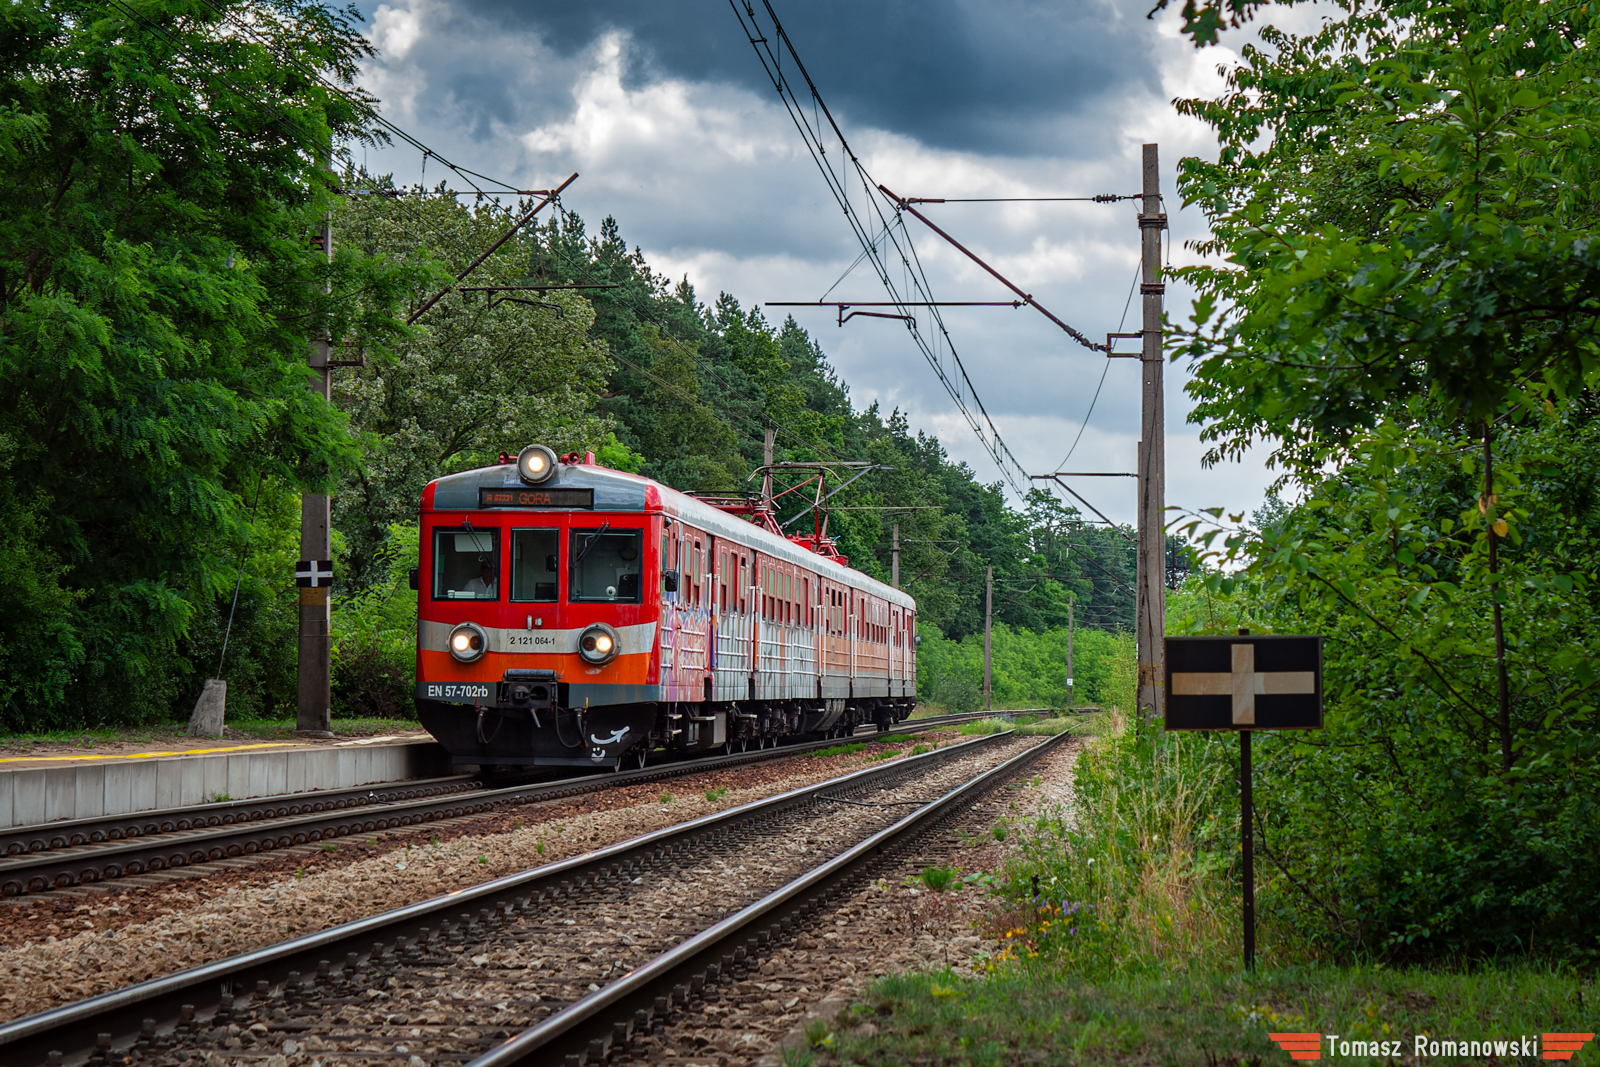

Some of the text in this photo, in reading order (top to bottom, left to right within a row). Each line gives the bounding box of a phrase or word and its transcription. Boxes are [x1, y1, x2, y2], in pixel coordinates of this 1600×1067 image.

[487, 494, 492, 502] R
[510, 637, 556, 645] 2 121 064-1
[428, 685, 489, 698] EN 57-702rb
